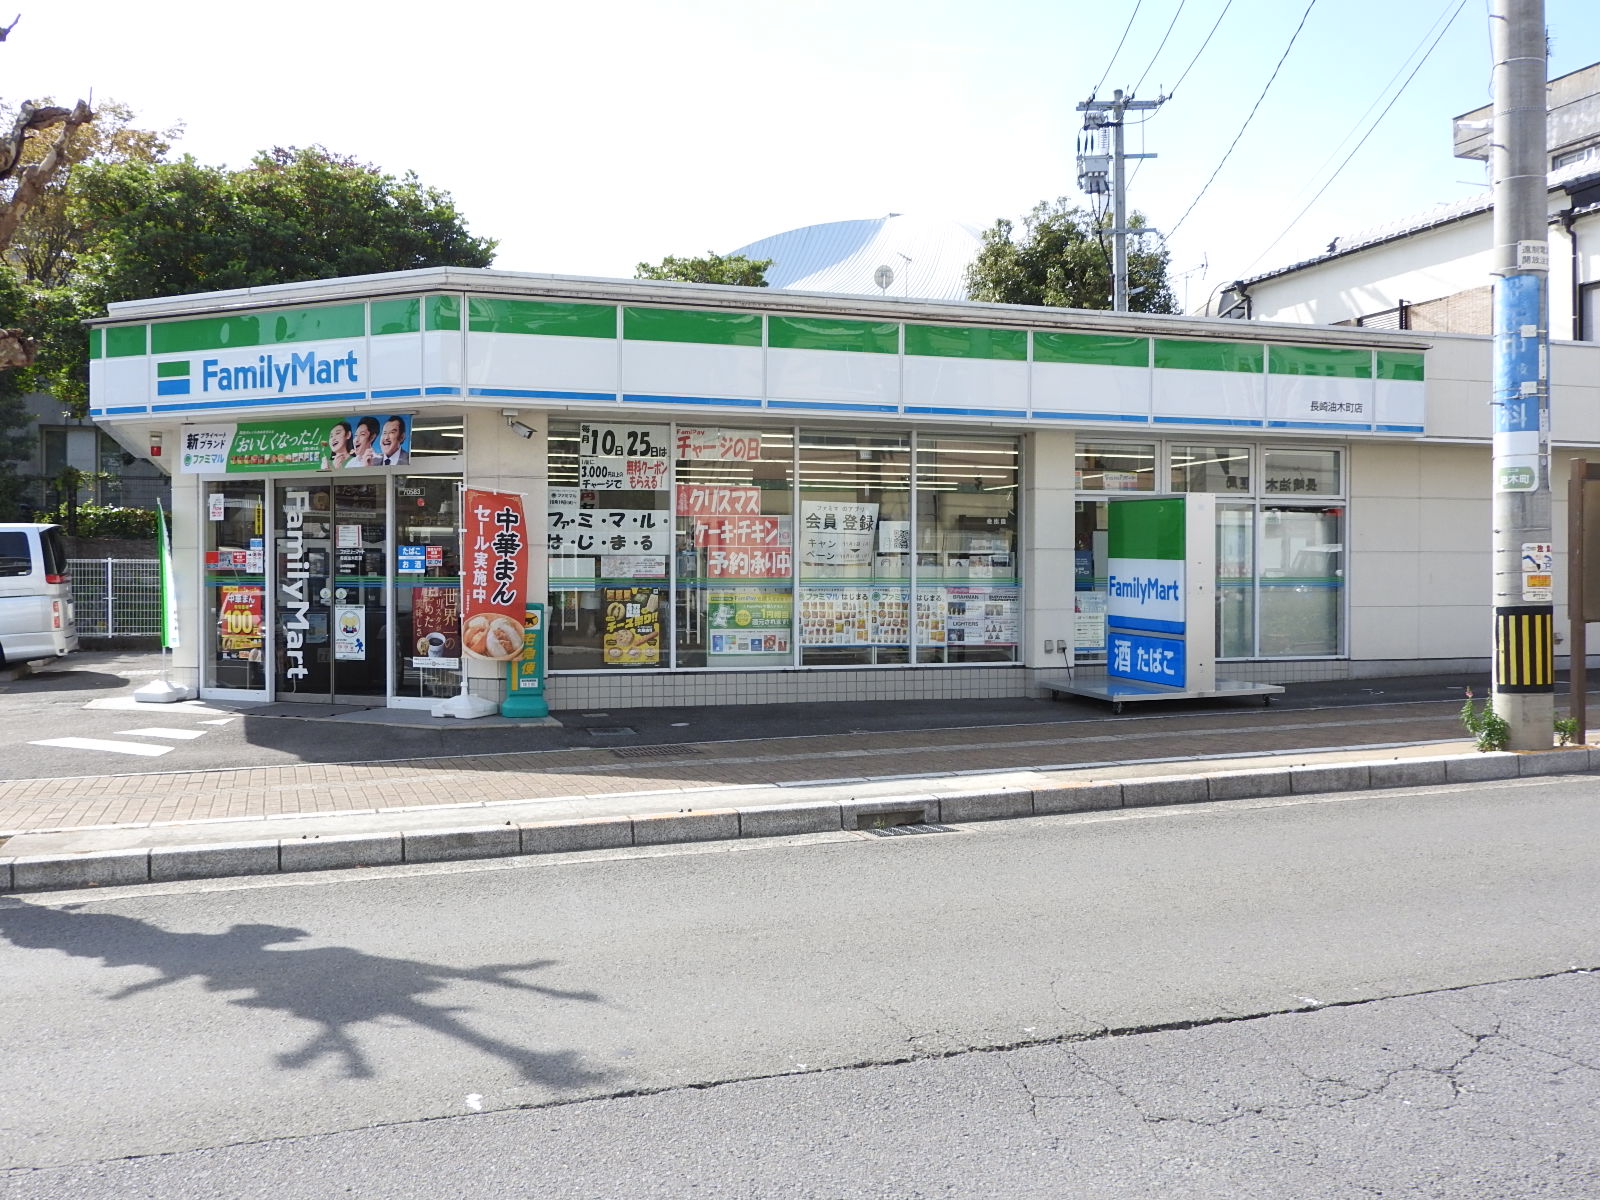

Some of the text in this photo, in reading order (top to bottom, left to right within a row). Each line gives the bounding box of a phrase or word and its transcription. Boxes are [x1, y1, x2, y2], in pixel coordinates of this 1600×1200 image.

[202, 350, 359, 393] FamilyMart
[1310, 400, 1363, 413] 長崎油木町店
[676, 428, 705, 437] FamiPay
[199, 439, 226, 450] ブランド
[676, 435, 761, 460] チャージの日
[192, 454, 225, 465] ファミマル
[626, 460, 668, 475] 無料クーポン
[581, 479, 622, 489] チャージで
[689, 487, 760, 513] クリスマス
[805, 512, 874, 532] 会員登録
[402, 547, 421, 555] たばこ
[807, 538, 837, 548] キャン
[472, 504, 522, 605] 中華まん セール実施中
[709, 550, 792, 576] 予約承り中
[282, 491, 310, 679] FamilyMart
[1109, 575, 1179, 605] FamilyMart
[841, 592, 869, 600] はじまる
[442, 587, 458, 650] 世界一の
[1114, 639, 1175, 676] 酒 たばこ
